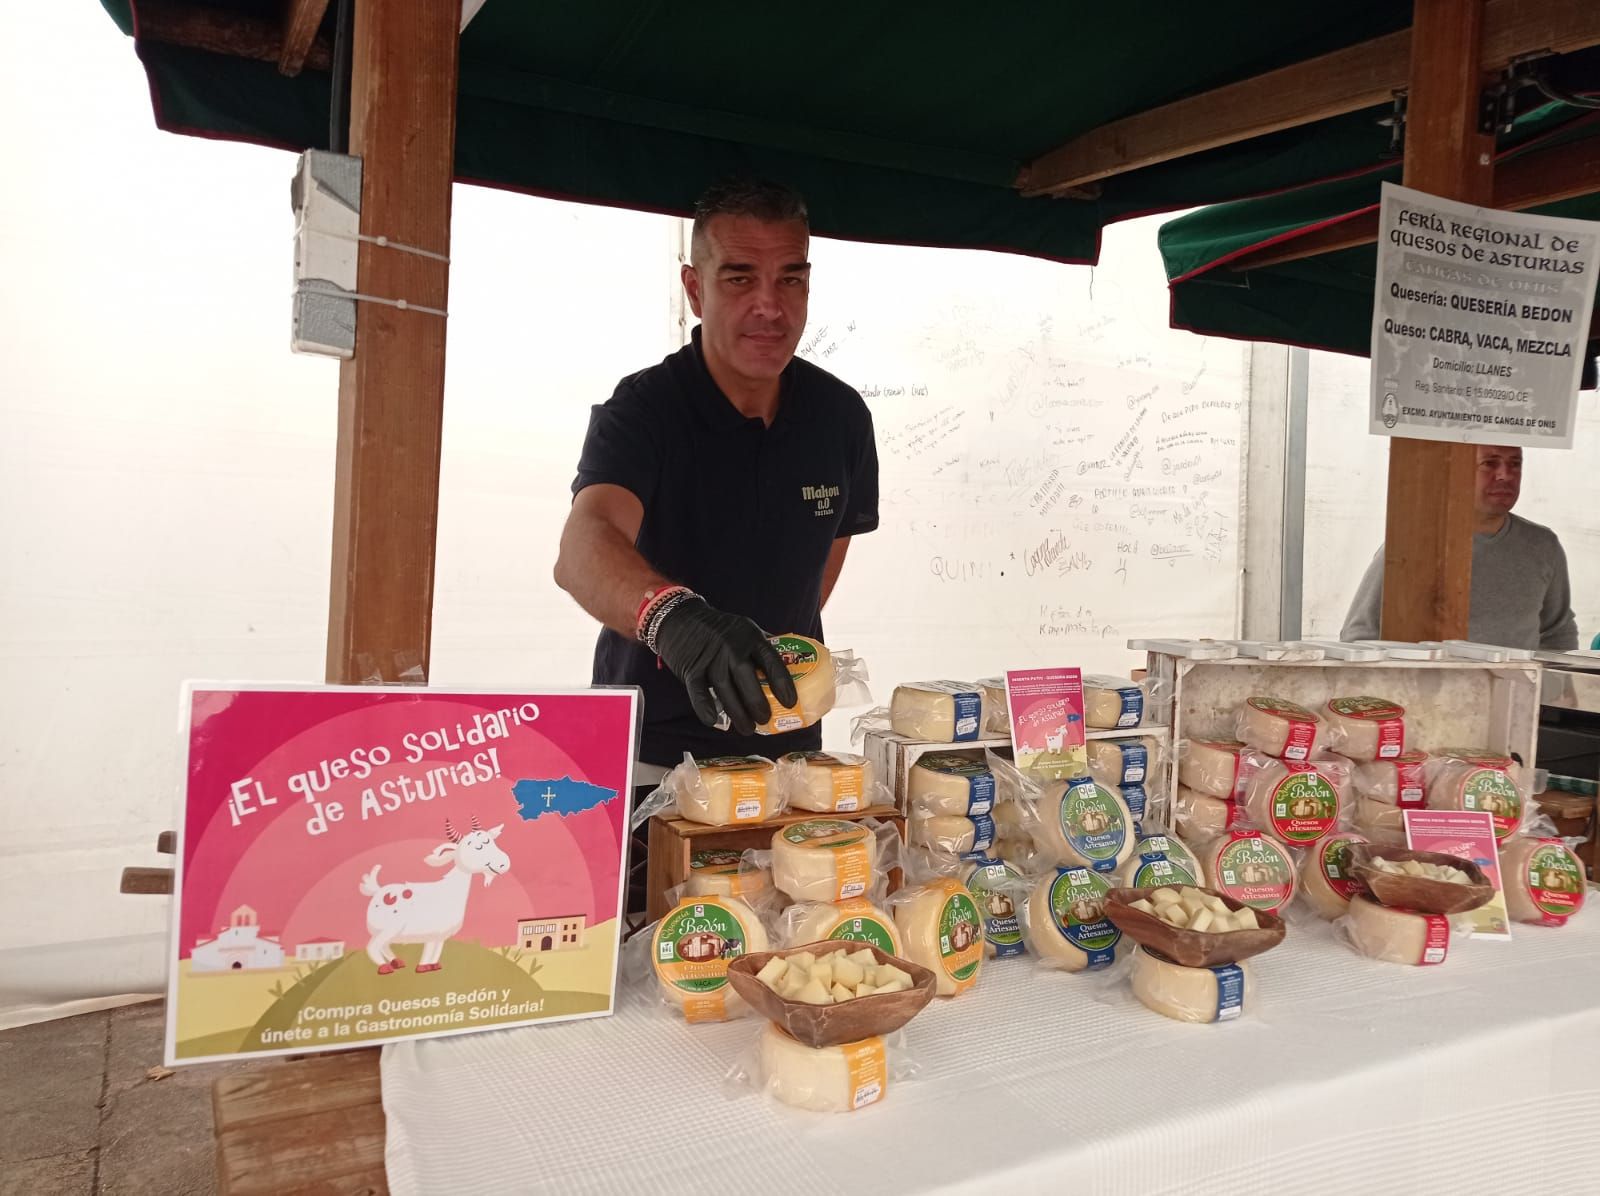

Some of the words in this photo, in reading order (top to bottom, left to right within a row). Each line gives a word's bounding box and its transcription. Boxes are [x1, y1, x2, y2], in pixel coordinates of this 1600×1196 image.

[1398, 210, 1446, 234] FERÍA
[1450, 222, 1544, 250] REGIONAL
[1551, 236, 1580, 253] DE
[1390, 229, 1457, 256] QUESOS
[1462, 244, 1485, 262] DE
[1489, 251, 1584, 274] ASTURIAS
[1390, 283, 1448, 307] Quesería:
[1450, 294, 1517, 318] QUESERÍA
[1522, 305, 1573, 323] BEDON
[1384, 318, 1426, 340] Queso:
[1430, 326, 1472, 349] CABRA,
[1477, 333, 1513, 354] VACA,
[1516, 339, 1572, 357] MEZCLA
[1433, 357, 1474, 374] Domicilio:
[1476, 363, 1512, 378] LLANES
[1402, 406, 1428, 416] EXCMO.
[1429, 409, 1482, 423] AYUNTAMIENTO
[1484, 415, 1493, 424] DE
[1494, 416, 1524, 426] CANGAS
[1538, 420, 1556, 428] ONIS
[802, 485, 840, 500] Mahou
[1290, 784, 1330, 798] Bedón
[1478, 778, 1516, 797] Bedón
[1076, 800, 1107, 815] Bedón
[306, 801, 344, 836] de
[1084, 840, 1116, 850] Artesanos
[1086, 835, 1110, 844] Quesos
[1236, 849, 1279, 864] Bedón
[1542, 855, 1576, 872] Bedón
[1067, 887, 1102, 901] Bedón
[679, 918, 726, 934] Bedón
[1078, 928, 1114, 939] Artesanos
[1080, 922, 1108, 932] Quesos
[297, 1001, 372, 1024] ¡Compra
[378, 995, 440, 1014] Quesos
[446, 989, 497, 1006] Bedón
[500, 989, 512, 1001] y
[261, 1026, 312, 1044] únete
[317, 1026, 329, 1038] a
[334, 1022, 350, 1036] la
[355, 1005, 465, 1034] Gastronomía
[468, 999, 546, 1021] Solidaria!
